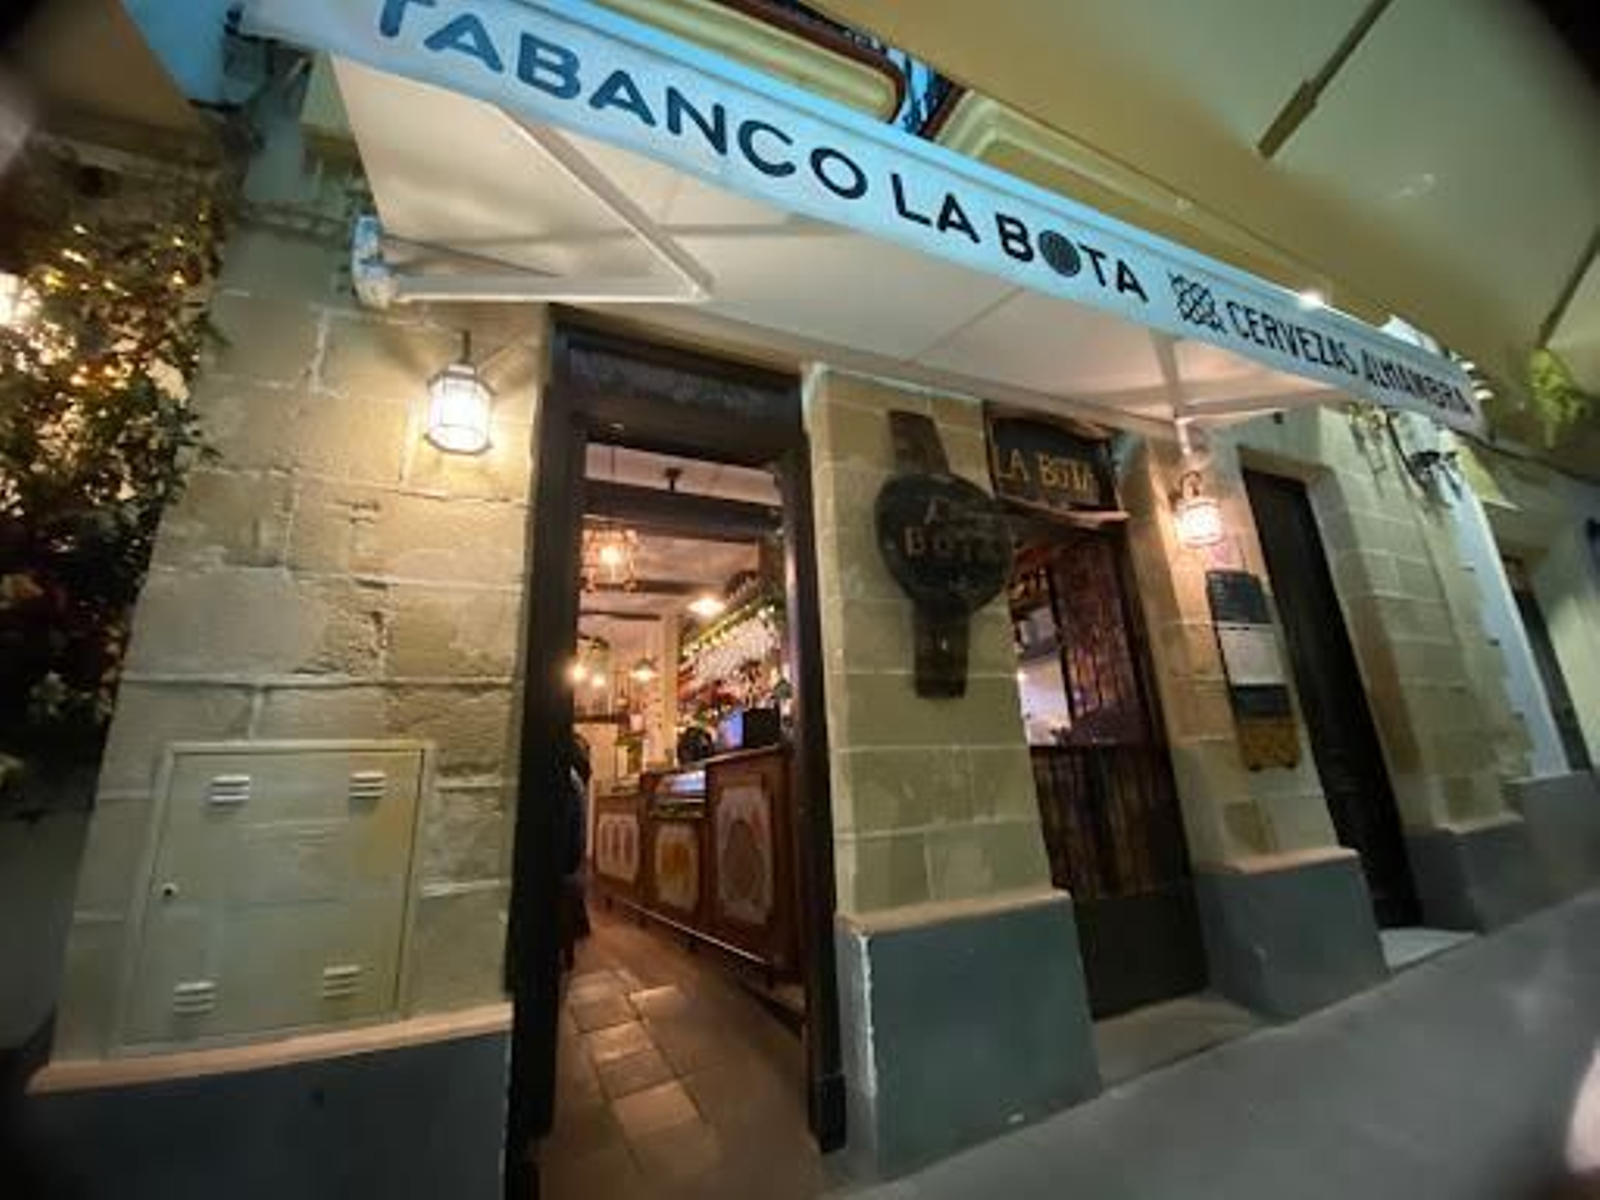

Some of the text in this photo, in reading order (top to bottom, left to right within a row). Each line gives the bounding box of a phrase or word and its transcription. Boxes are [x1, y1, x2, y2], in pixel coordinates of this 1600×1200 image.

[379, 0, 1149, 303] TABANCO LA BOTA
[1226, 301, 1357, 375] CERVEZAS
